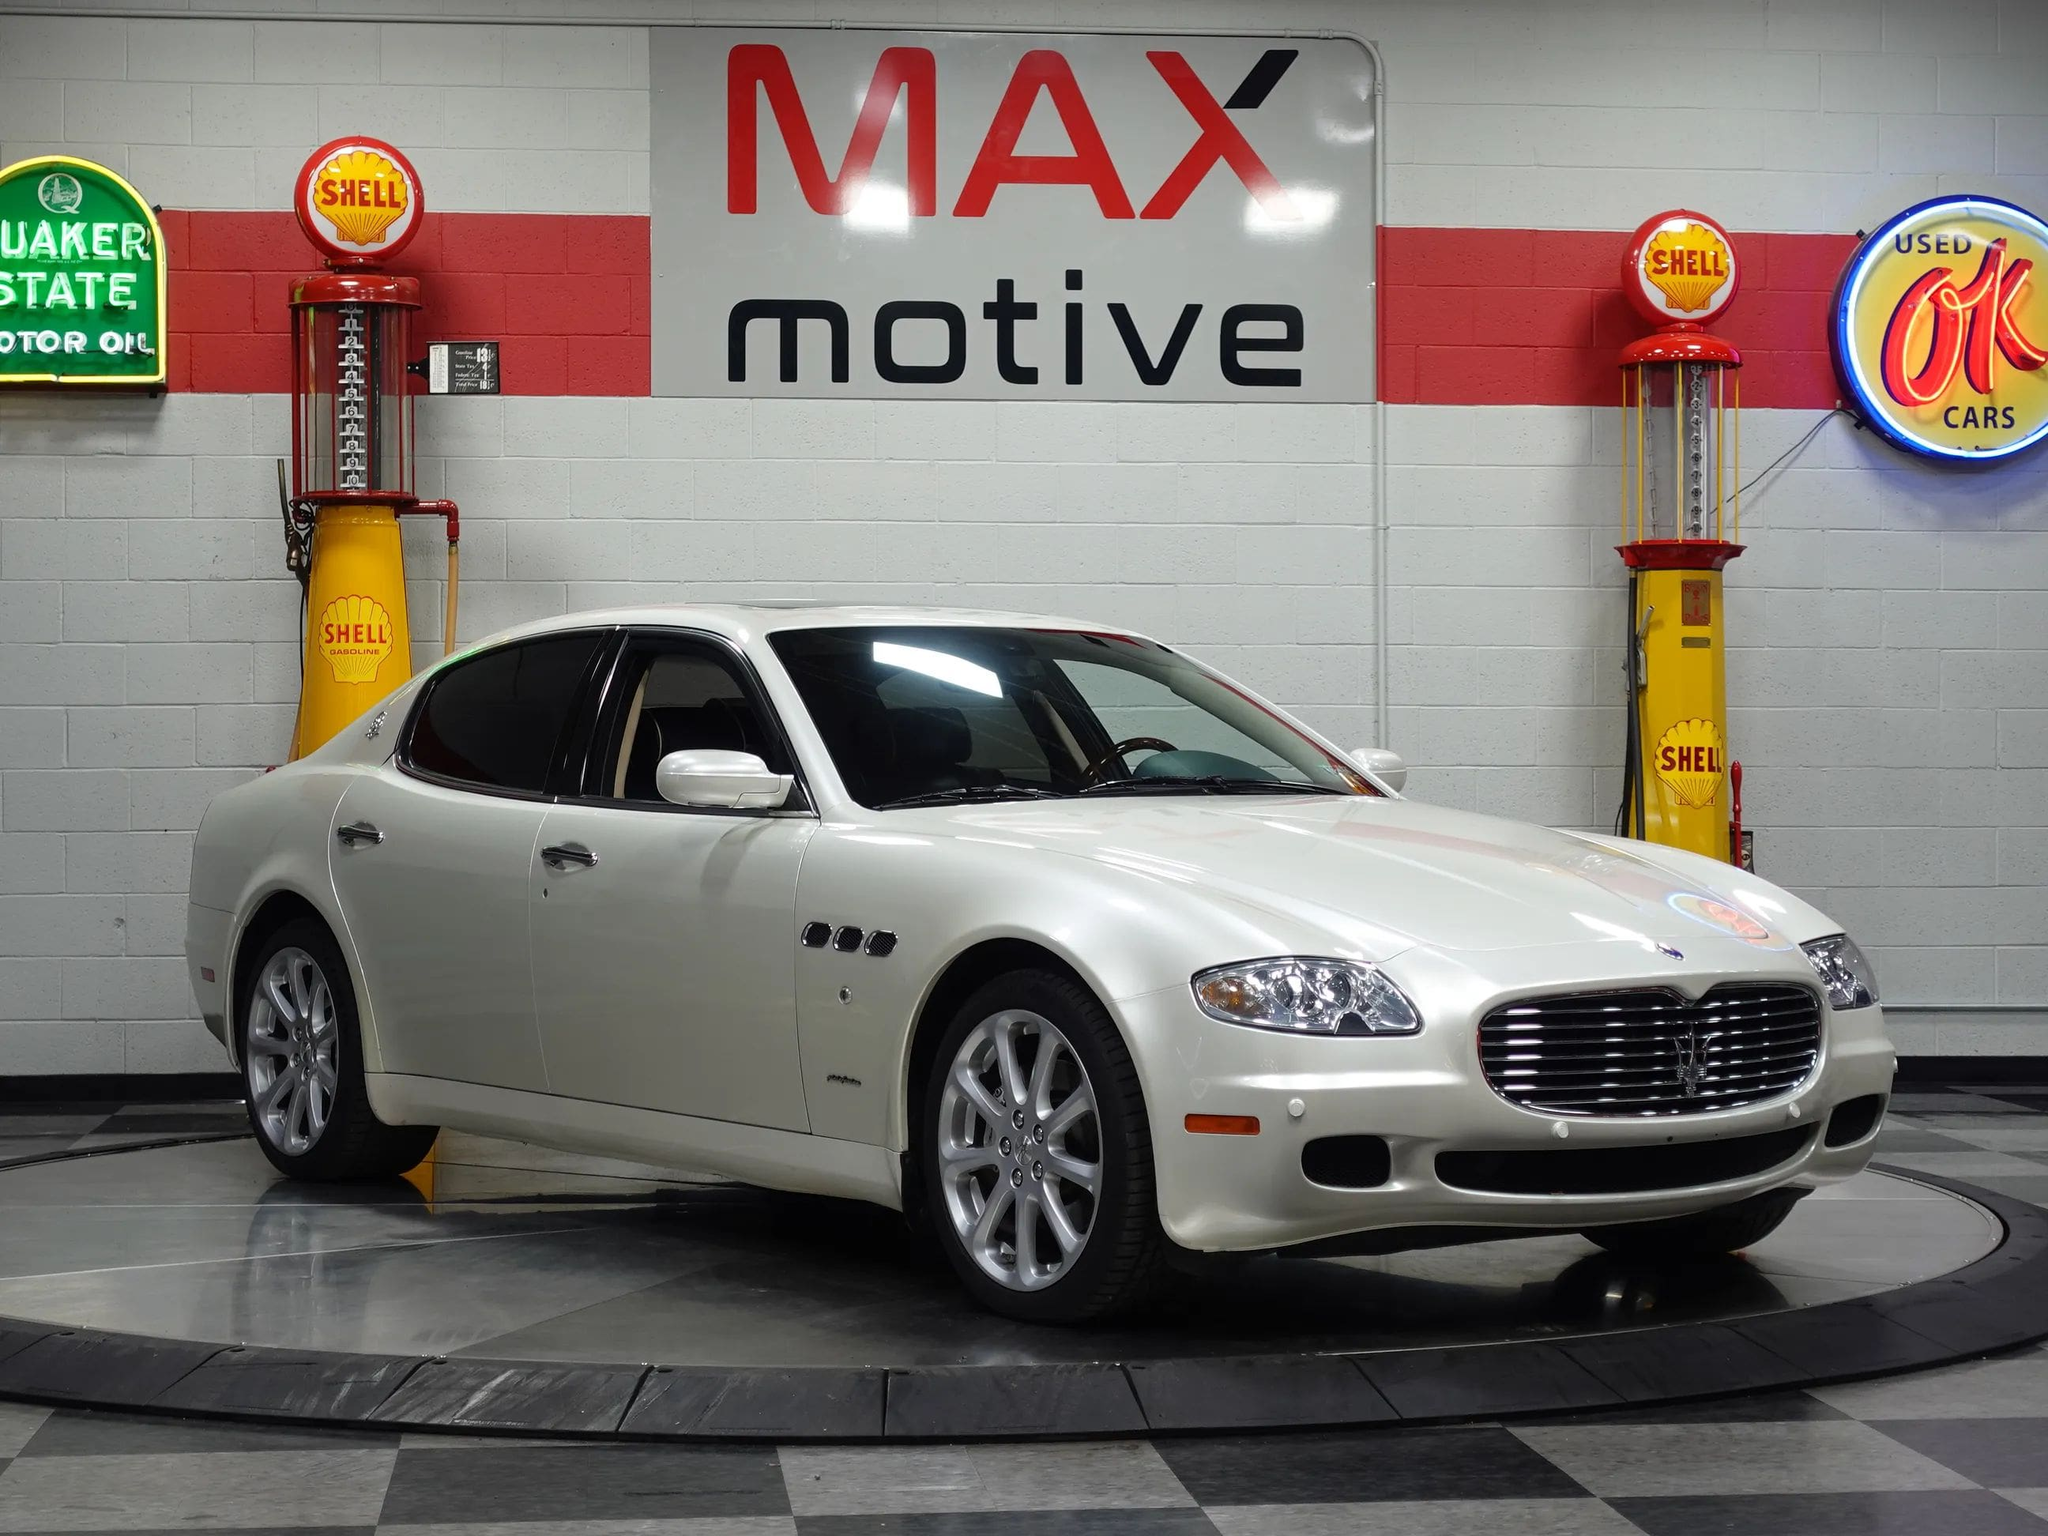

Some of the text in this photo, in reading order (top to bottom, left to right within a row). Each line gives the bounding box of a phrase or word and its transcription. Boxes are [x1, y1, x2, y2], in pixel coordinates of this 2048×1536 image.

[728, 44, 1300, 220] MAX
[321, 179, 402, 208] SHELL
[0, 219, 151, 260] UAKER
[1895, 233, 1972, 254] USED
[1652, 249, 1724, 277] SHELL
[0, 272, 137, 310] STATE
[728, 269, 1304, 387] motive
[0, 330, 155, 355] OTOR OIL
[1943, 406, 2016, 429] CARS
[324, 623, 387, 645] SHELL
[1660, 746, 1722, 773] SHELL
